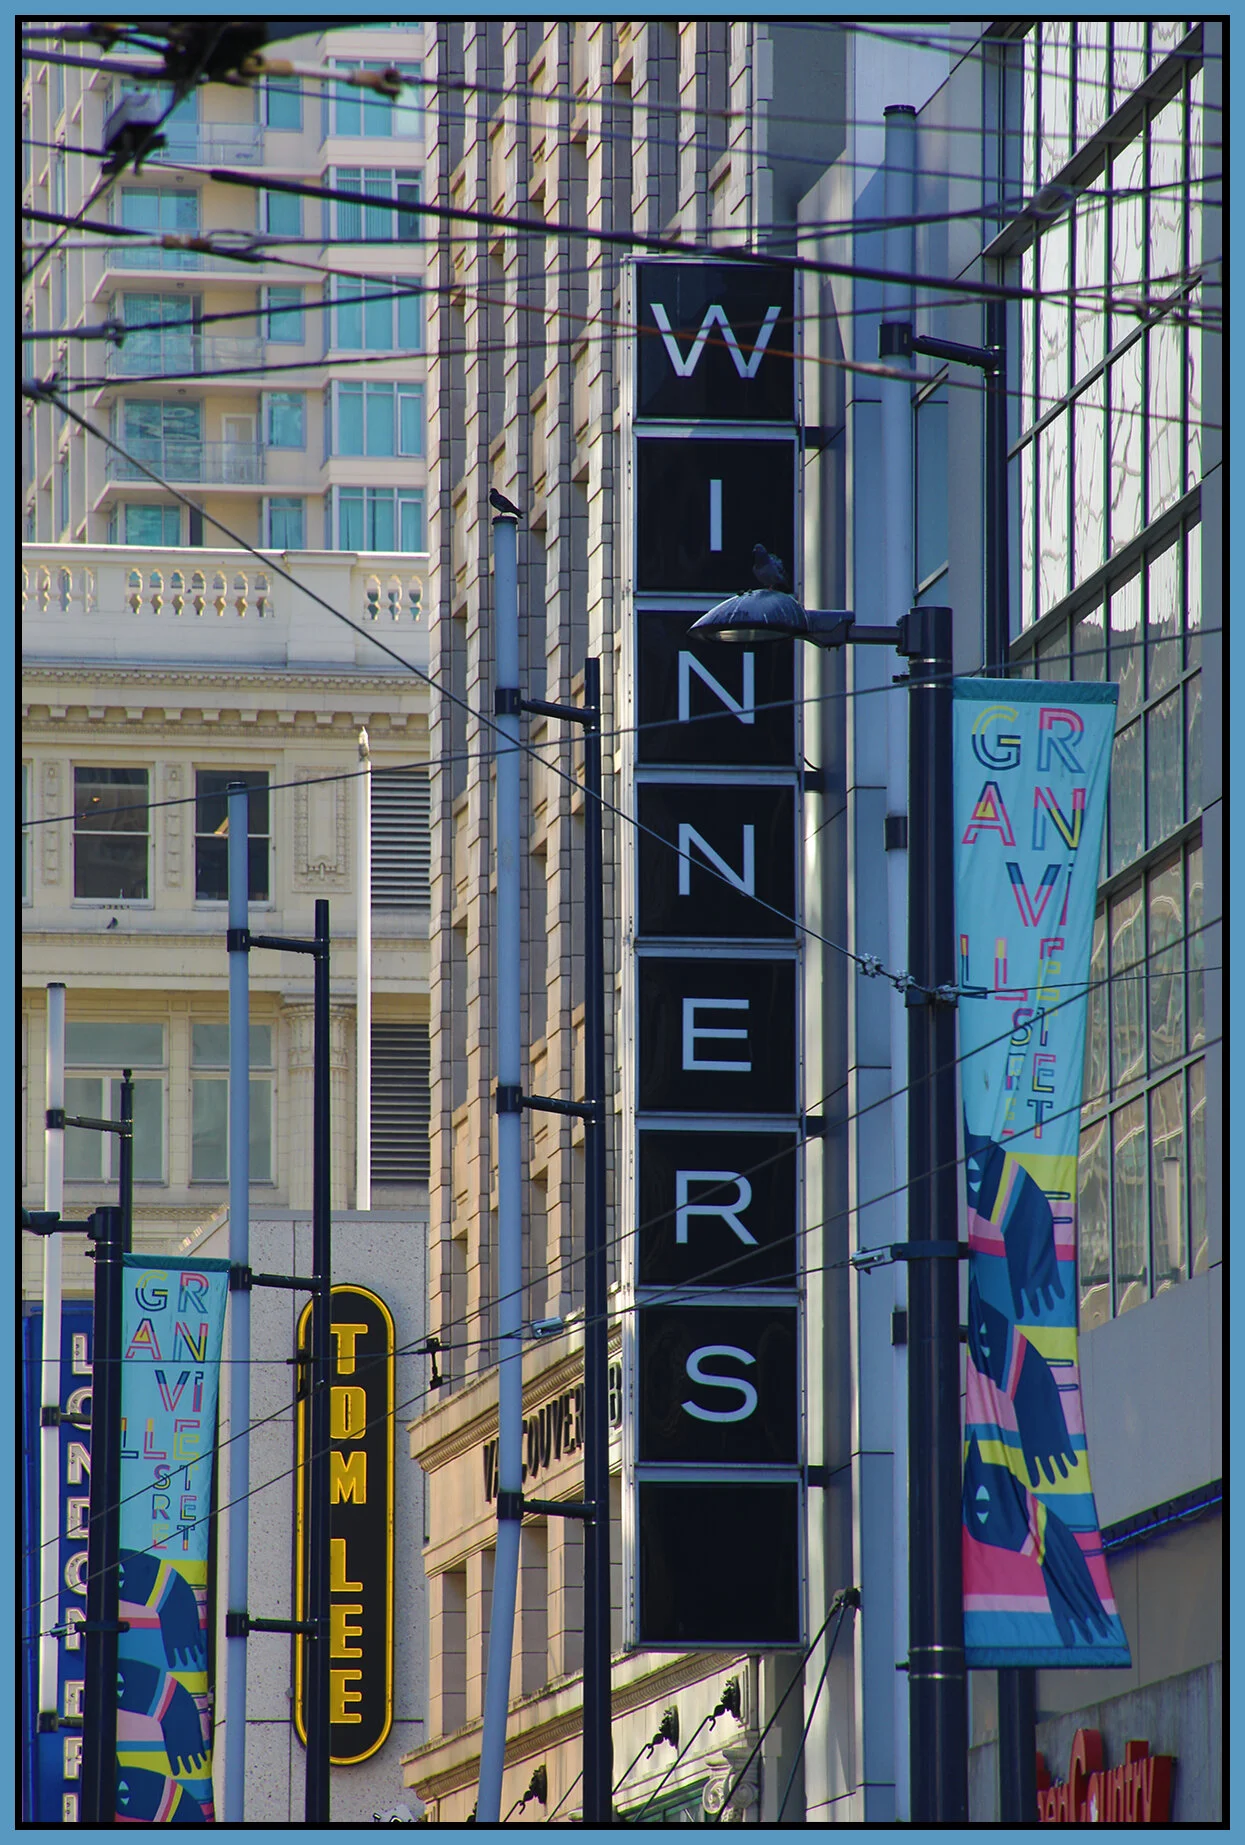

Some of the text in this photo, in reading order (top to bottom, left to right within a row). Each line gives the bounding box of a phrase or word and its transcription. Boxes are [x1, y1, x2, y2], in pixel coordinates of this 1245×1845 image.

[650, 303, 782, 1423] WINNERS
[330, 1323, 368, 1724] TOM LEE
[483, 1382, 584, 1503] VOUVER
